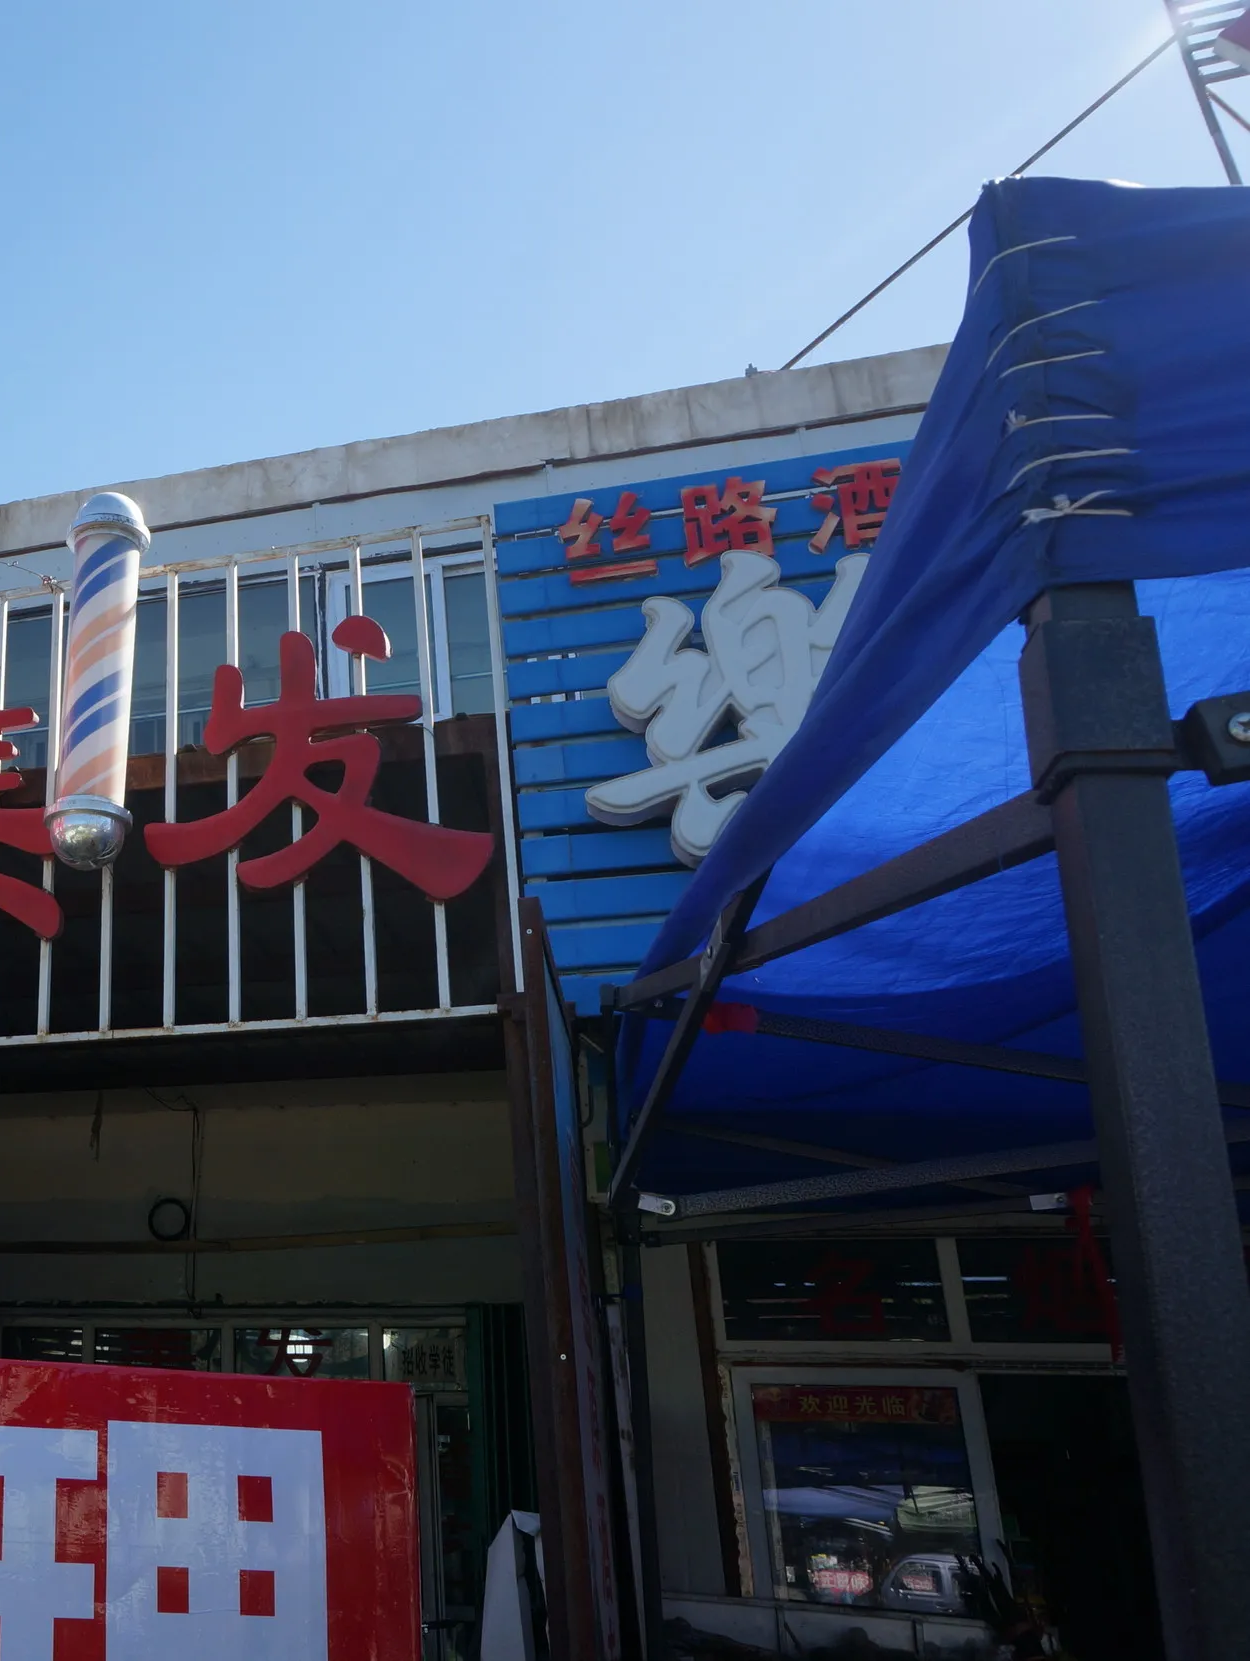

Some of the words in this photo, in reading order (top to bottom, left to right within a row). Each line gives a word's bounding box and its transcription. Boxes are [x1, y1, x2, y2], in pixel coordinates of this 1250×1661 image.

[401, 1344, 456, 1377] 招收学徒
[797, 1393, 908, 1417] 欢迎光临
